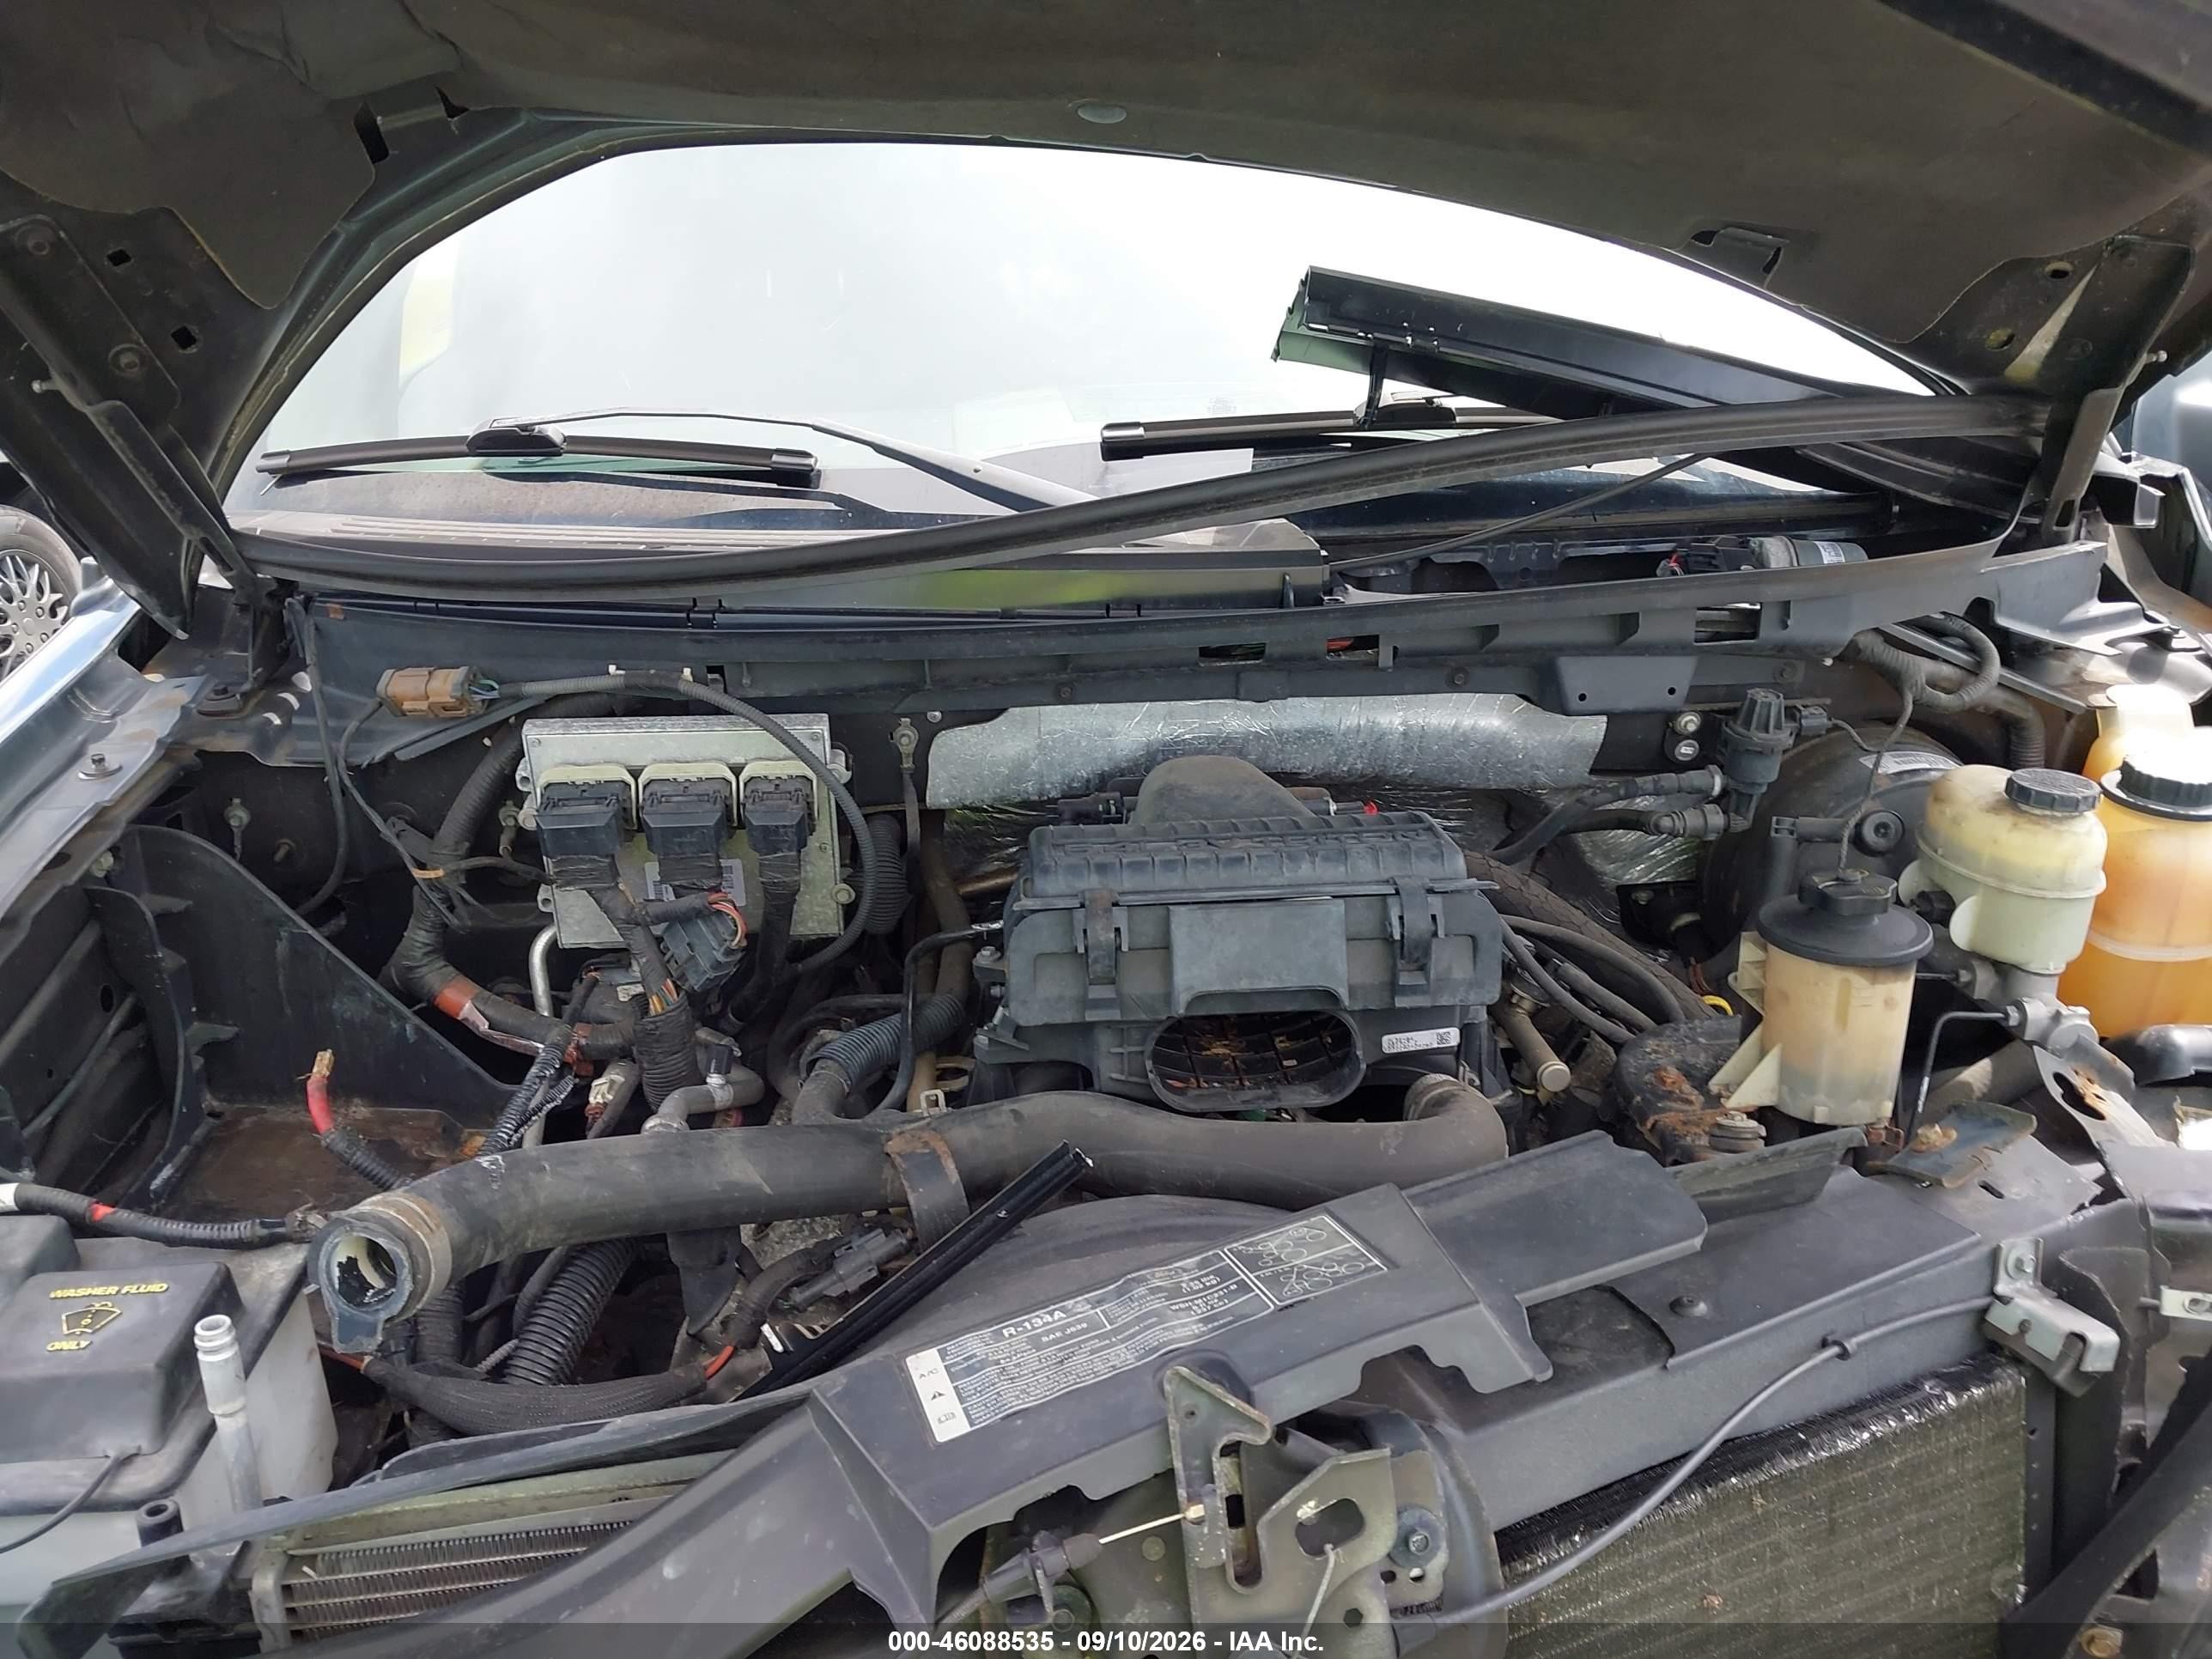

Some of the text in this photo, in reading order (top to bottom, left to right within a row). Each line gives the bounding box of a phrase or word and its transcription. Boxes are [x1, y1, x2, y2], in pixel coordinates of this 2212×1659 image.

[49, 1282, 170, 1299] WASHER FLUID
[1002, 1310, 1066, 1338] R-134A
[46, 1340, 93, 1352] ONLY
[919, 1367, 940, 1381] A/C
